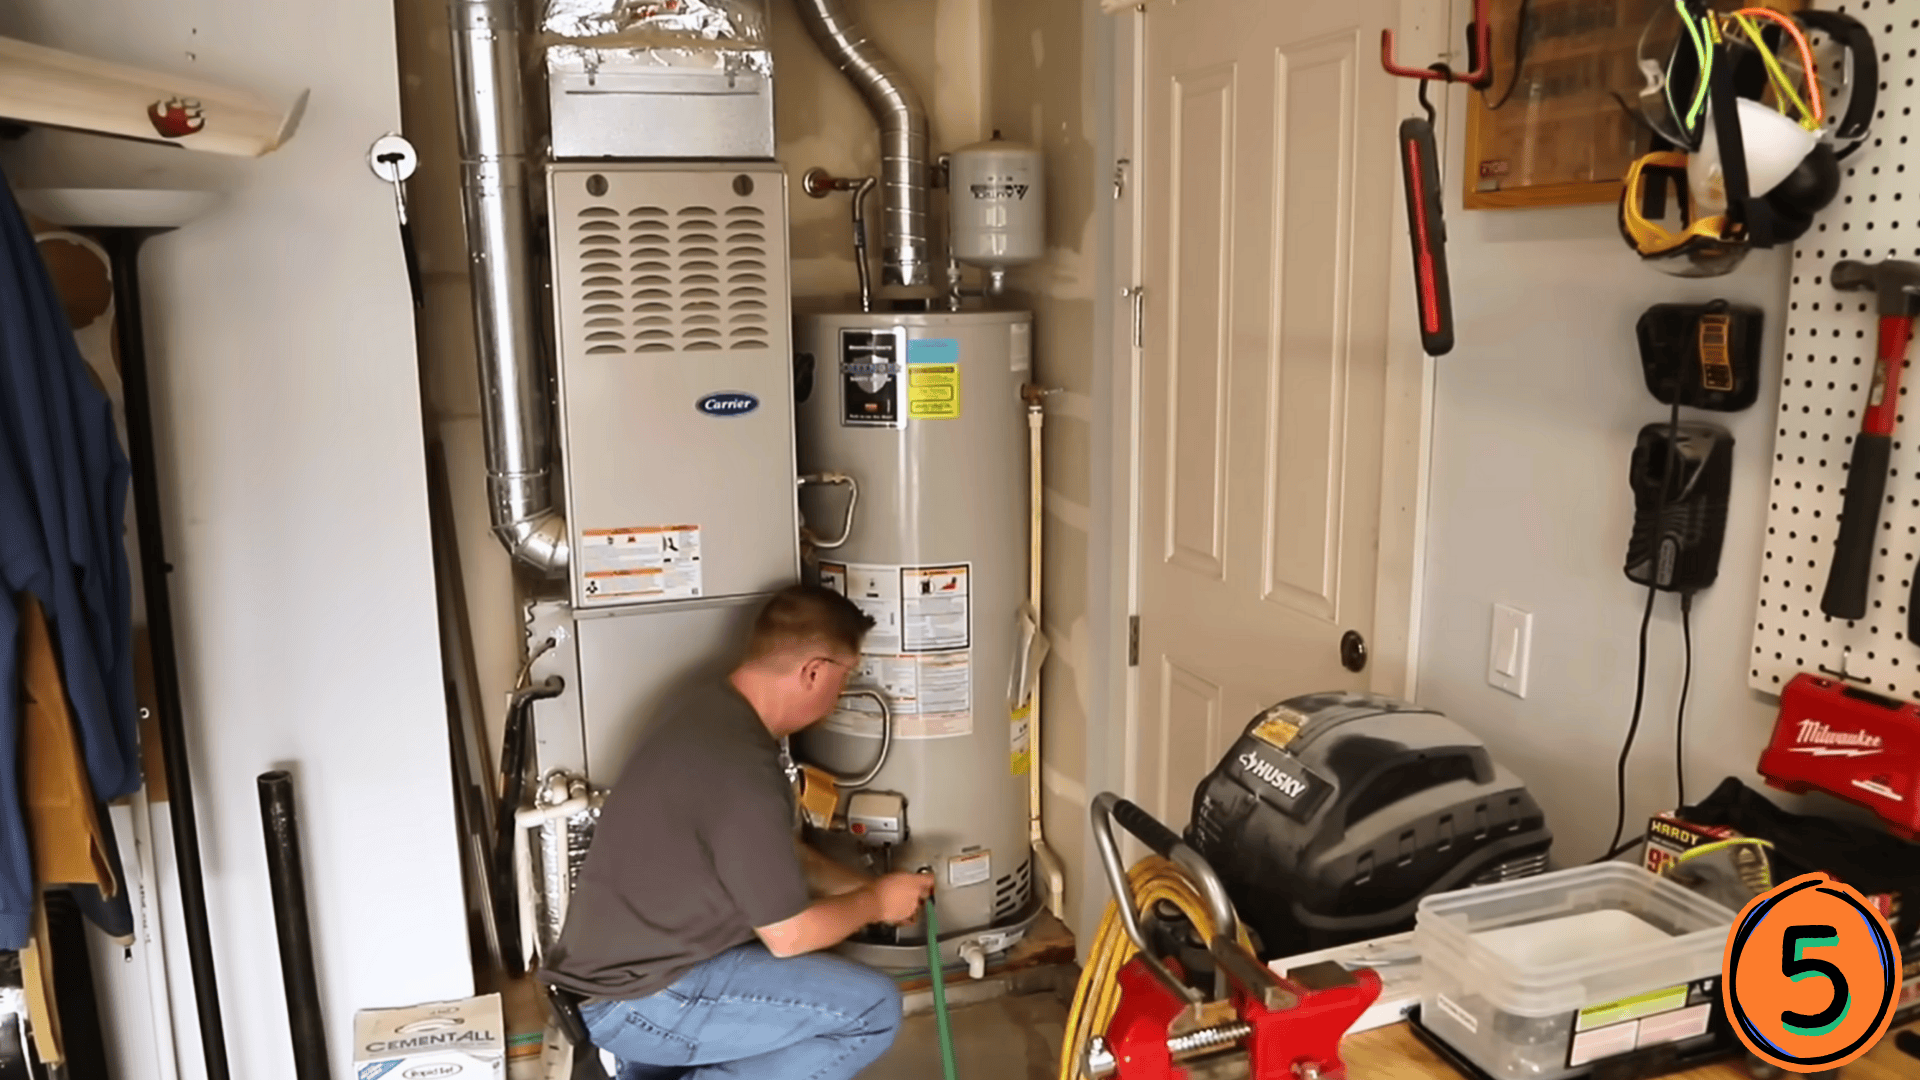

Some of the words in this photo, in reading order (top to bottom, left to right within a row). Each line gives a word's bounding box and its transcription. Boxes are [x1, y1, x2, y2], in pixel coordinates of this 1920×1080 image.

[704, 398, 752, 411] Carrier
[1796, 719, 1882, 747] Milwaukee
[1251, 759, 1306, 798] HUSKY
[1650, 820, 1699, 846] HARDY
